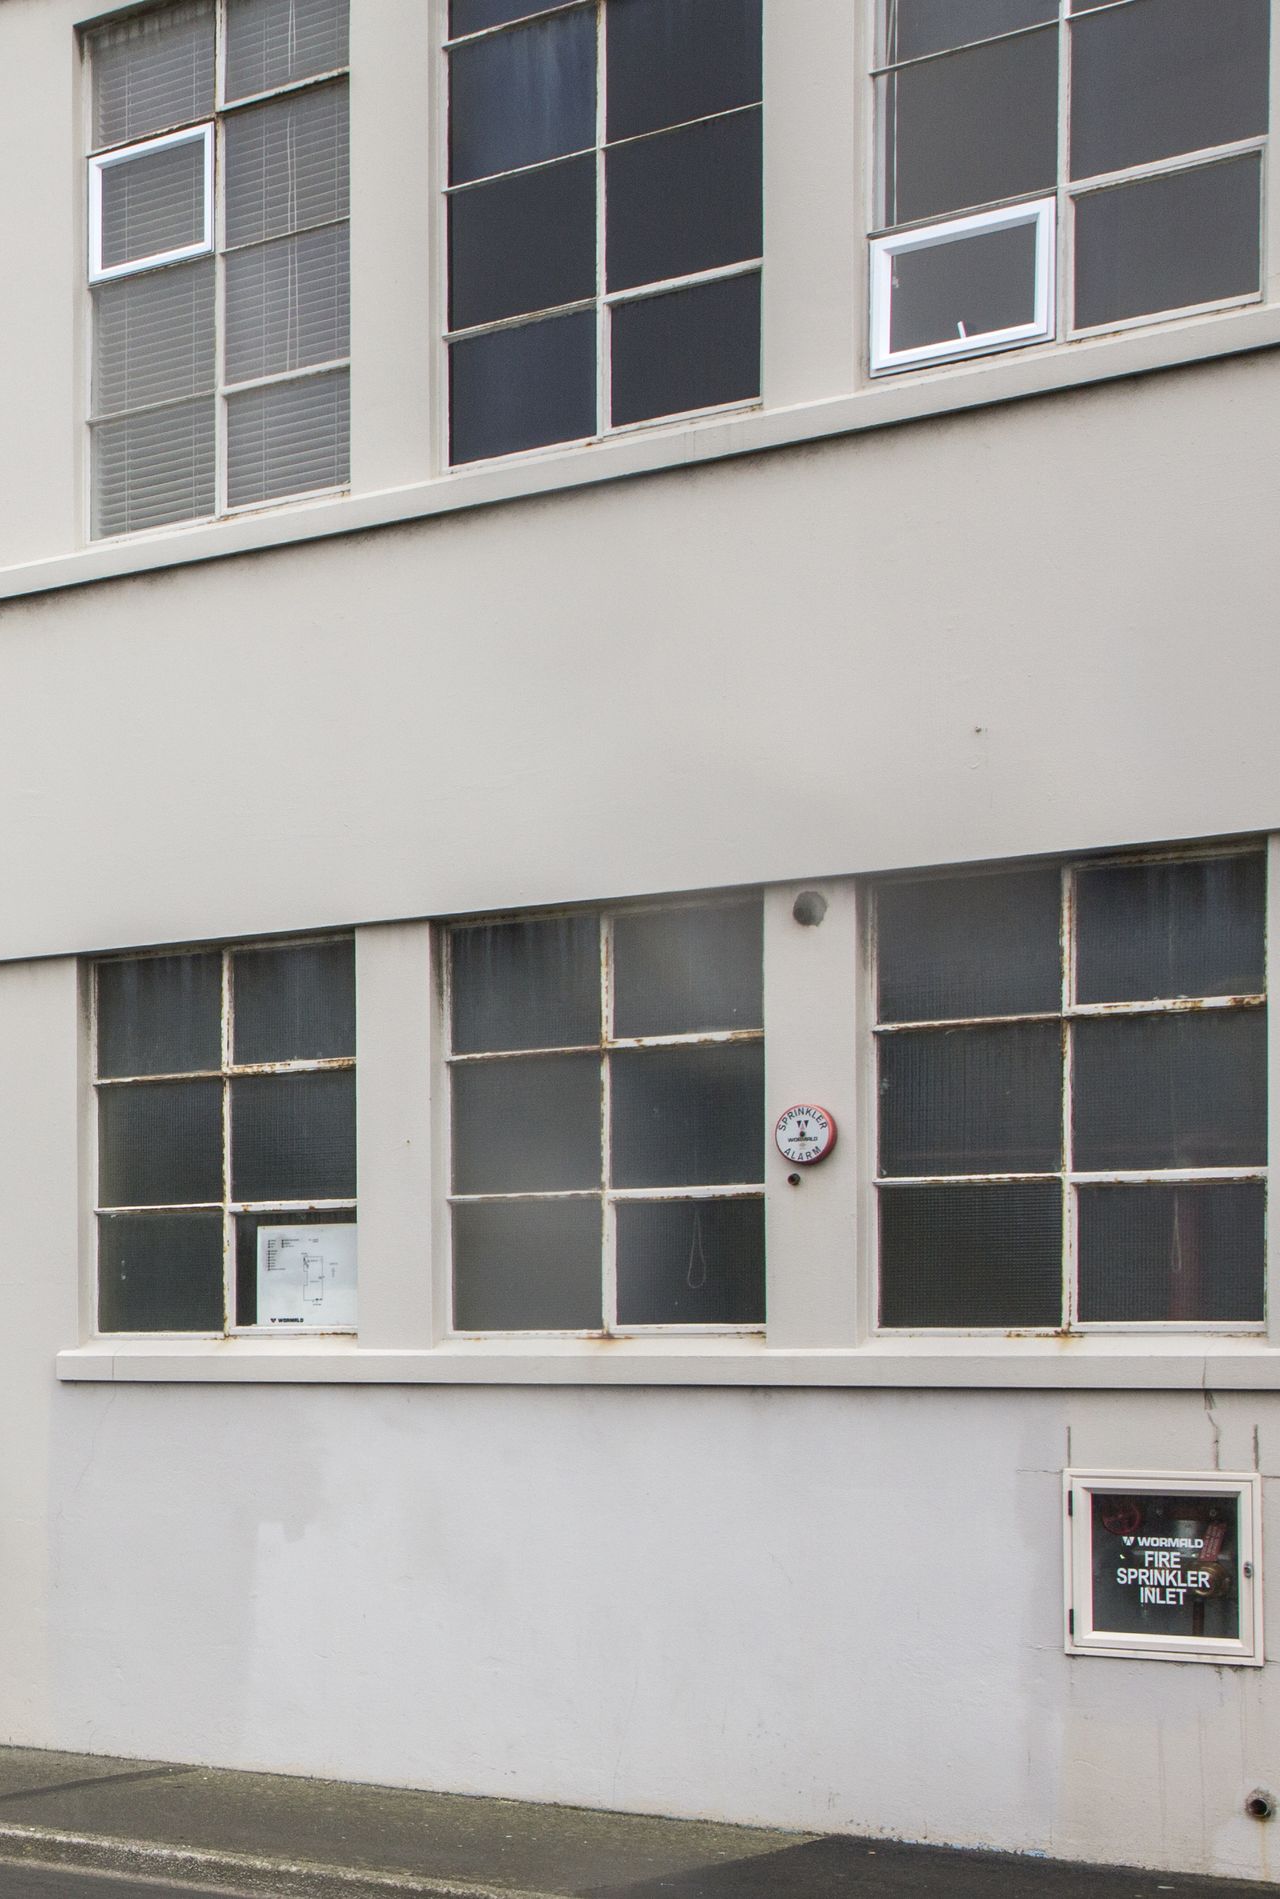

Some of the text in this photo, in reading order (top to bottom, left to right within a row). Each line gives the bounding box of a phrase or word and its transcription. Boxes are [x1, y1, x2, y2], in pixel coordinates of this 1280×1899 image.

[779, 1107, 828, 1131] SPRINKLER
[784, 1146, 821, 1160] ALARM
[1137, 1536, 1204, 1549] WORMALD
[1144, 1551, 1181, 1569] FIRE
[1116, 1568, 1210, 1588] SPRINKLER
[1140, 1587, 1187, 1605] INLET
